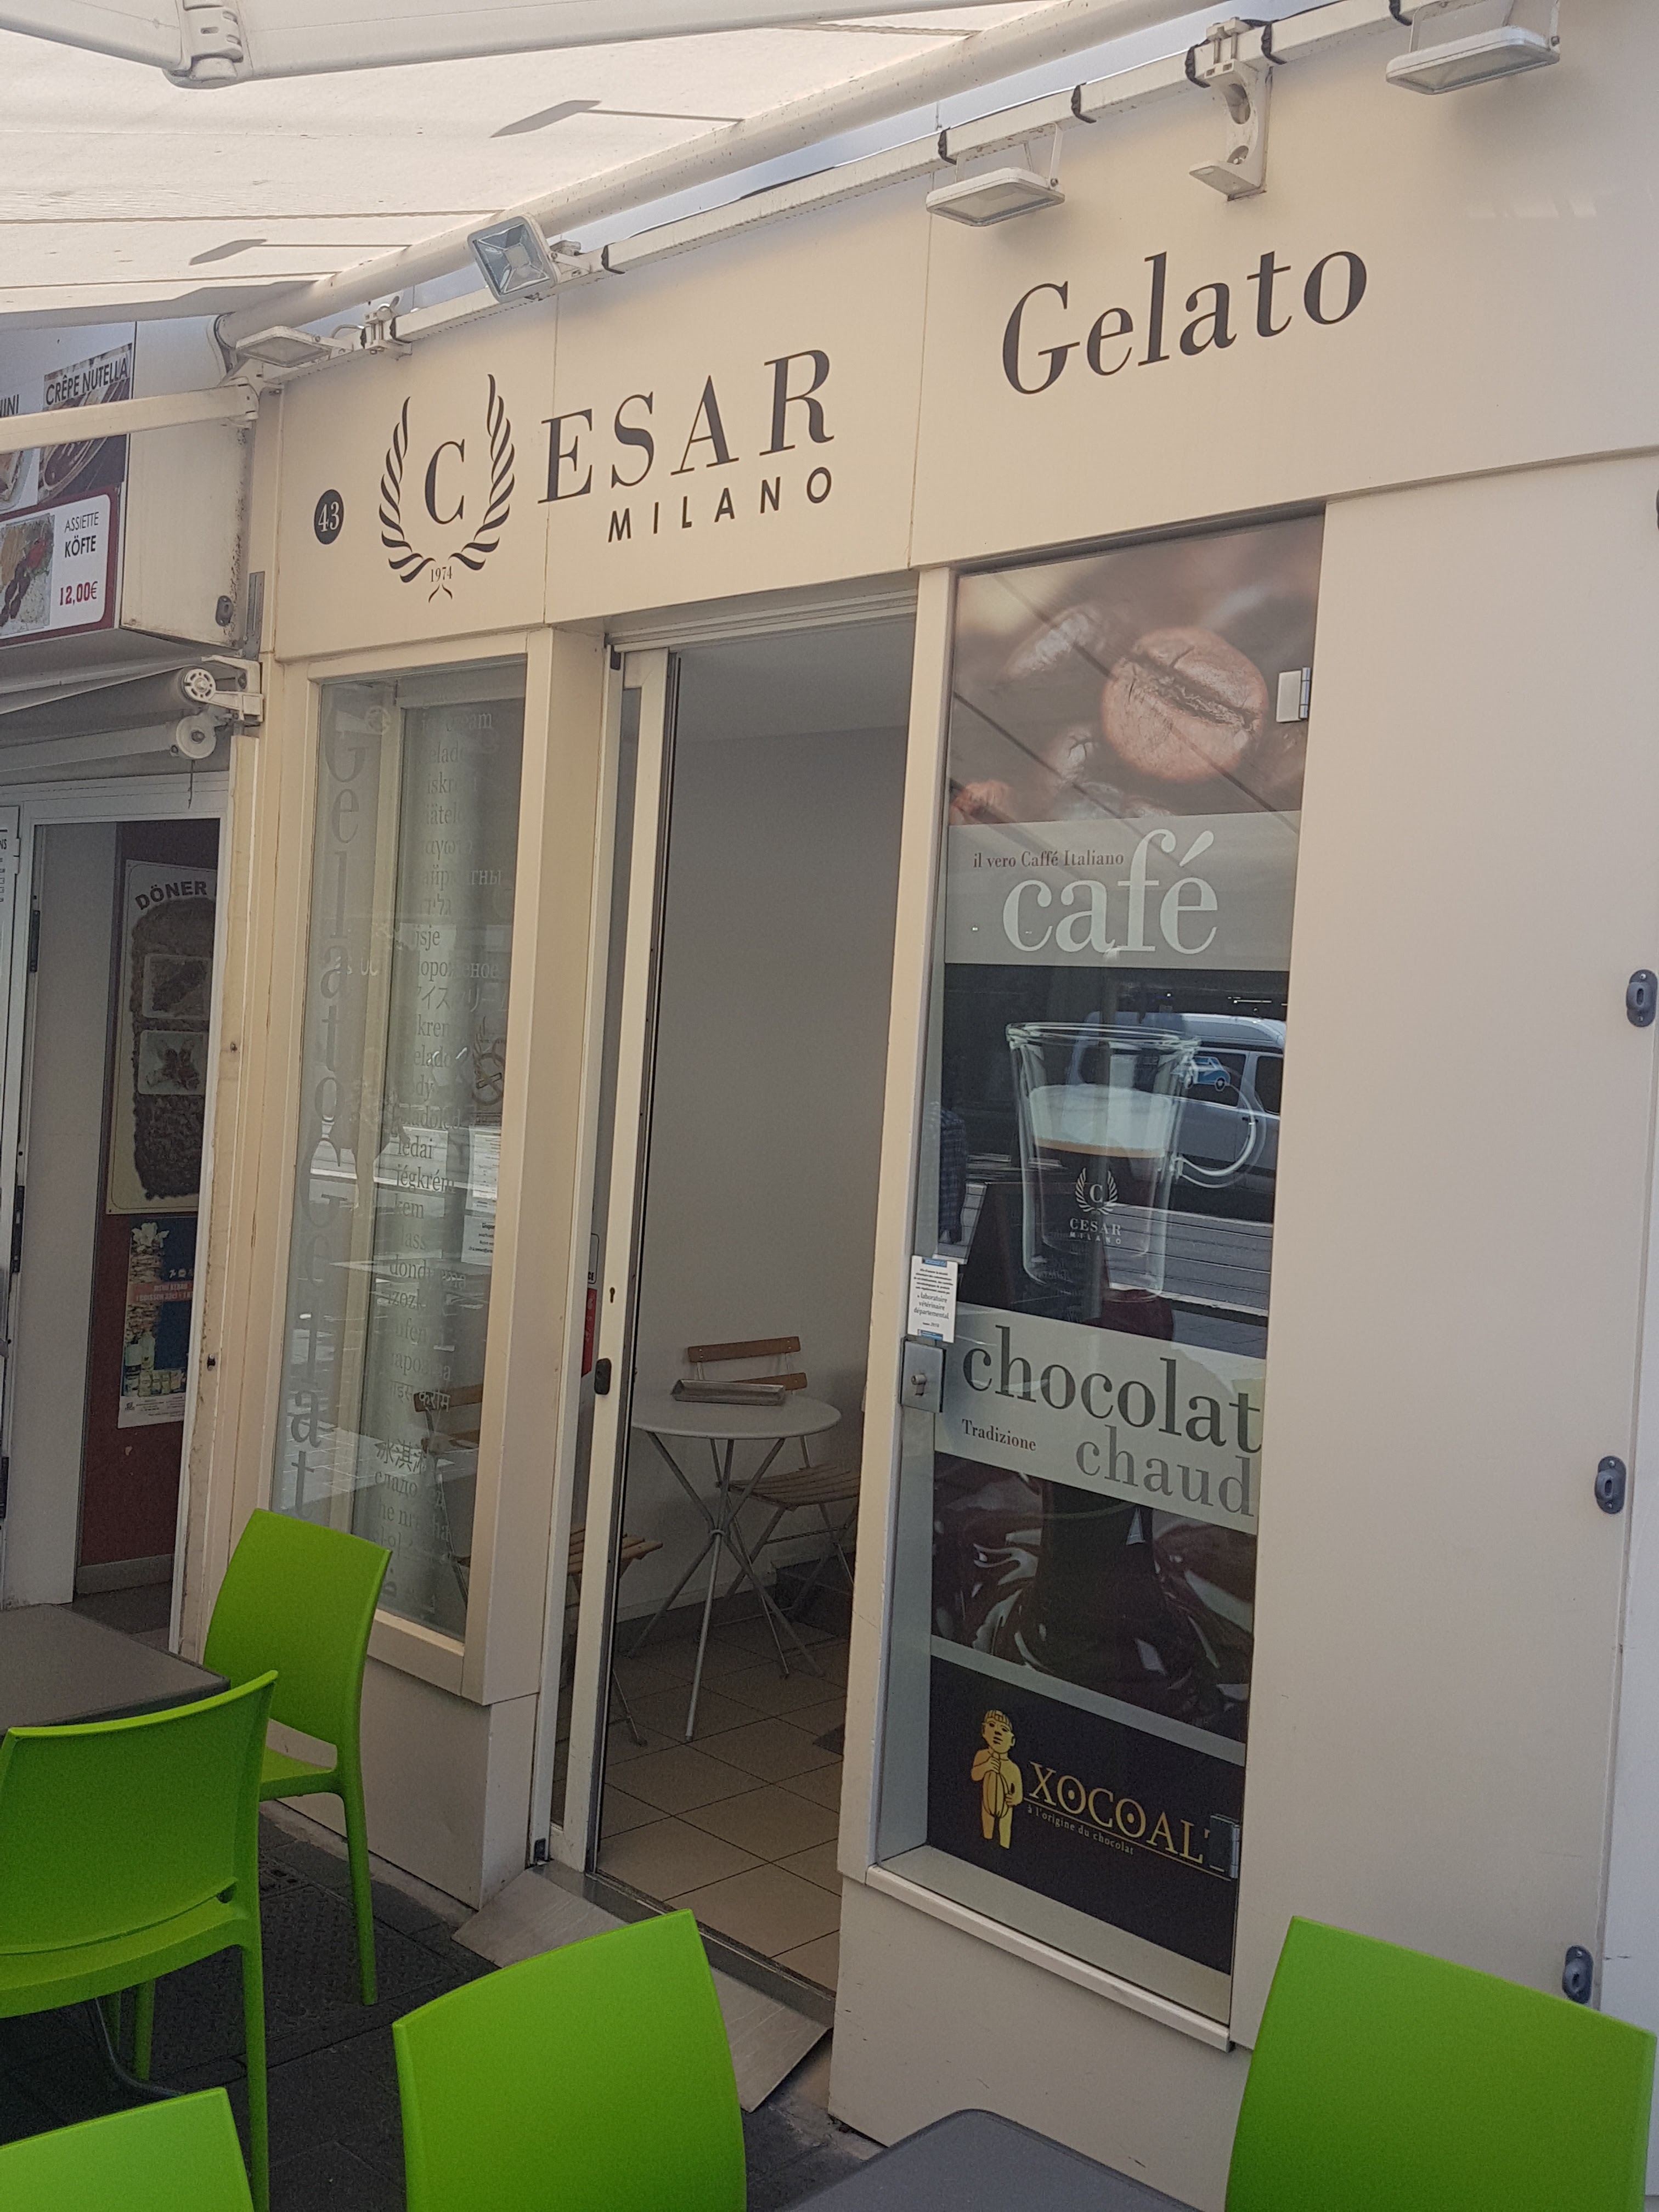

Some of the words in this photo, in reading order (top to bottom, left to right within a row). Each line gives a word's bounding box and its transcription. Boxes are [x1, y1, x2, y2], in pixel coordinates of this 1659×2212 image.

[1002, 250, 1368, 395] Gelato
[46, 374, 80, 405] CRÊPE
[83, 358, 128, 393] NUTELLA
[318, 500, 340, 532] 43
[607, 466, 832, 543] MILANO
[65, 511, 99, 533] ASSIETTE
[65, 535, 97, 558] KÖFTE
[430, 566, 453, 583] 1974
[59, 580, 98, 606] 12,00€
[973, 852, 982, 868] il
[986, 856, 1016, 868] vero
[1021, 850, 1059, 867] Caffé
[1063, 849, 1125, 867] Italiano
[135, 880, 207, 911] DÖNER
[1002, 828, 1218, 955] café
[1069, 1217, 1121, 1236] CESAR
[1069, 1231, 1121, 1245] MILANO
[962, 1324, 1263, 1454] chocolat
[962, 1418, 1037, 1452] Tradizione
[1076, 1424, 1256, 1518] chaud
[1027, 1804, 1032, 1814] à
[1036, 1807, 1075, 1831] l'origine
[1078, 1824, 1090, 1838] du
[1093, 1832, 1134, 1855] chocolat
